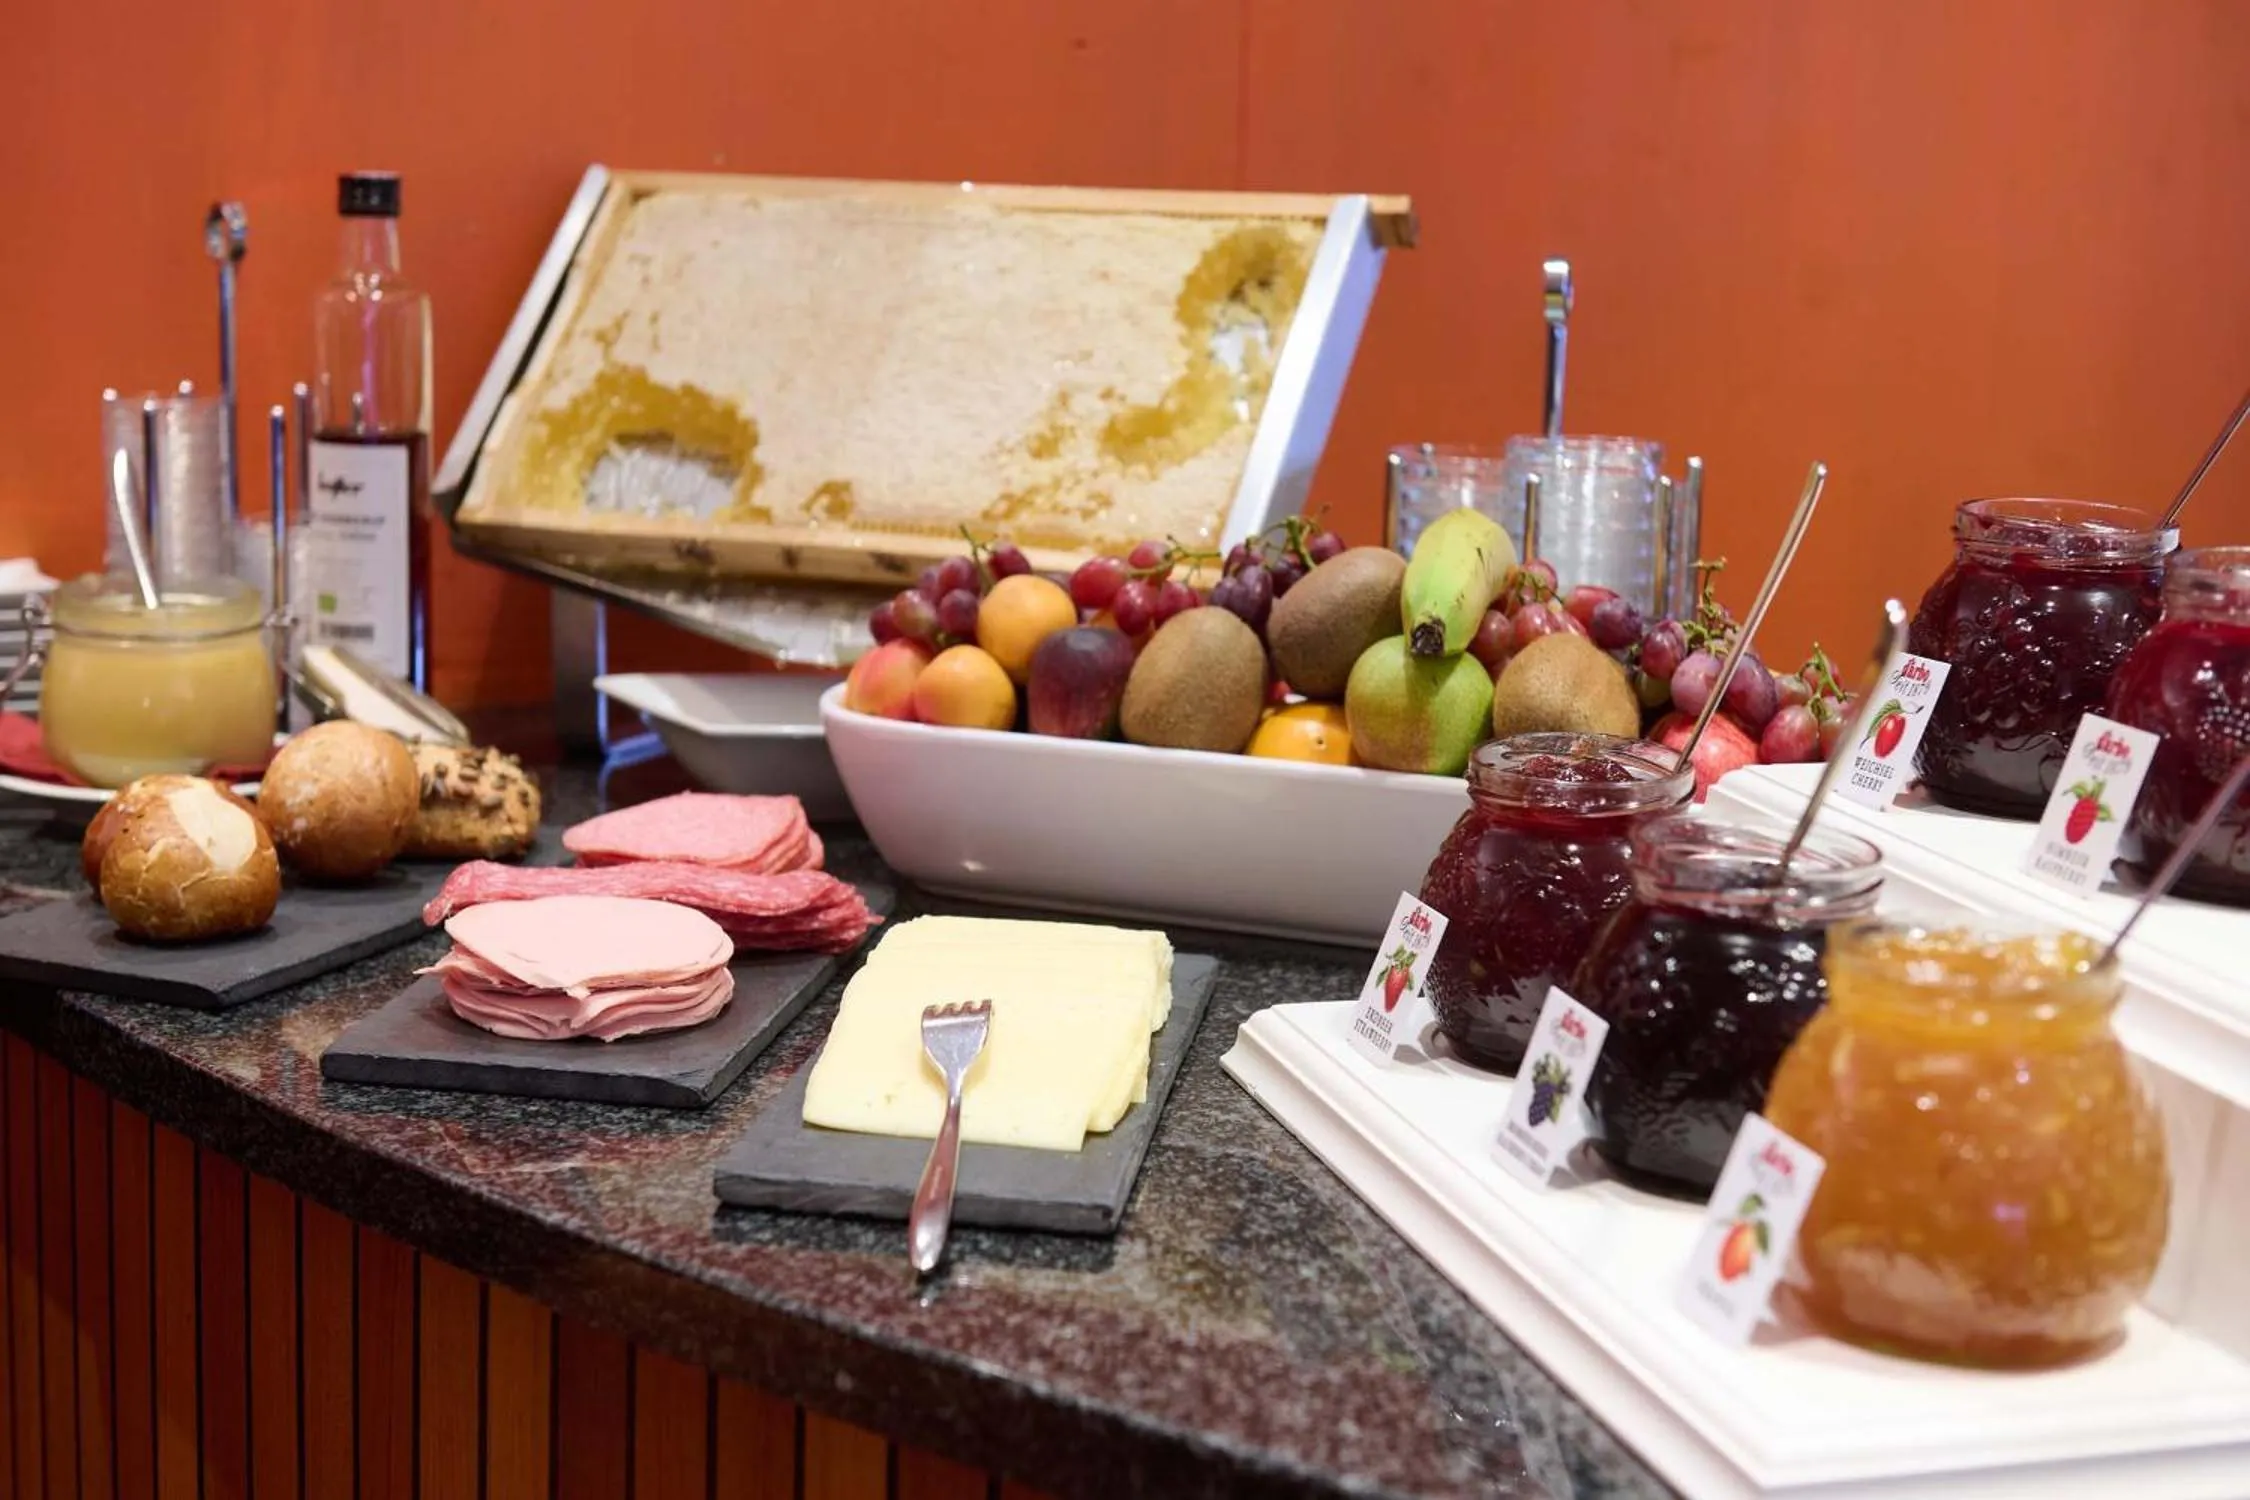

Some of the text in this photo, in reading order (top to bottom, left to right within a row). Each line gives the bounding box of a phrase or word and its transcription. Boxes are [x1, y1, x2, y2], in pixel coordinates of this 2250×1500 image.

[1854, 756, 1895, 779] WEICHSEL
[1851, 772, 1884, 792] CHERRY
[1354, 1018, 1392, 1054] STRAWBERRY
